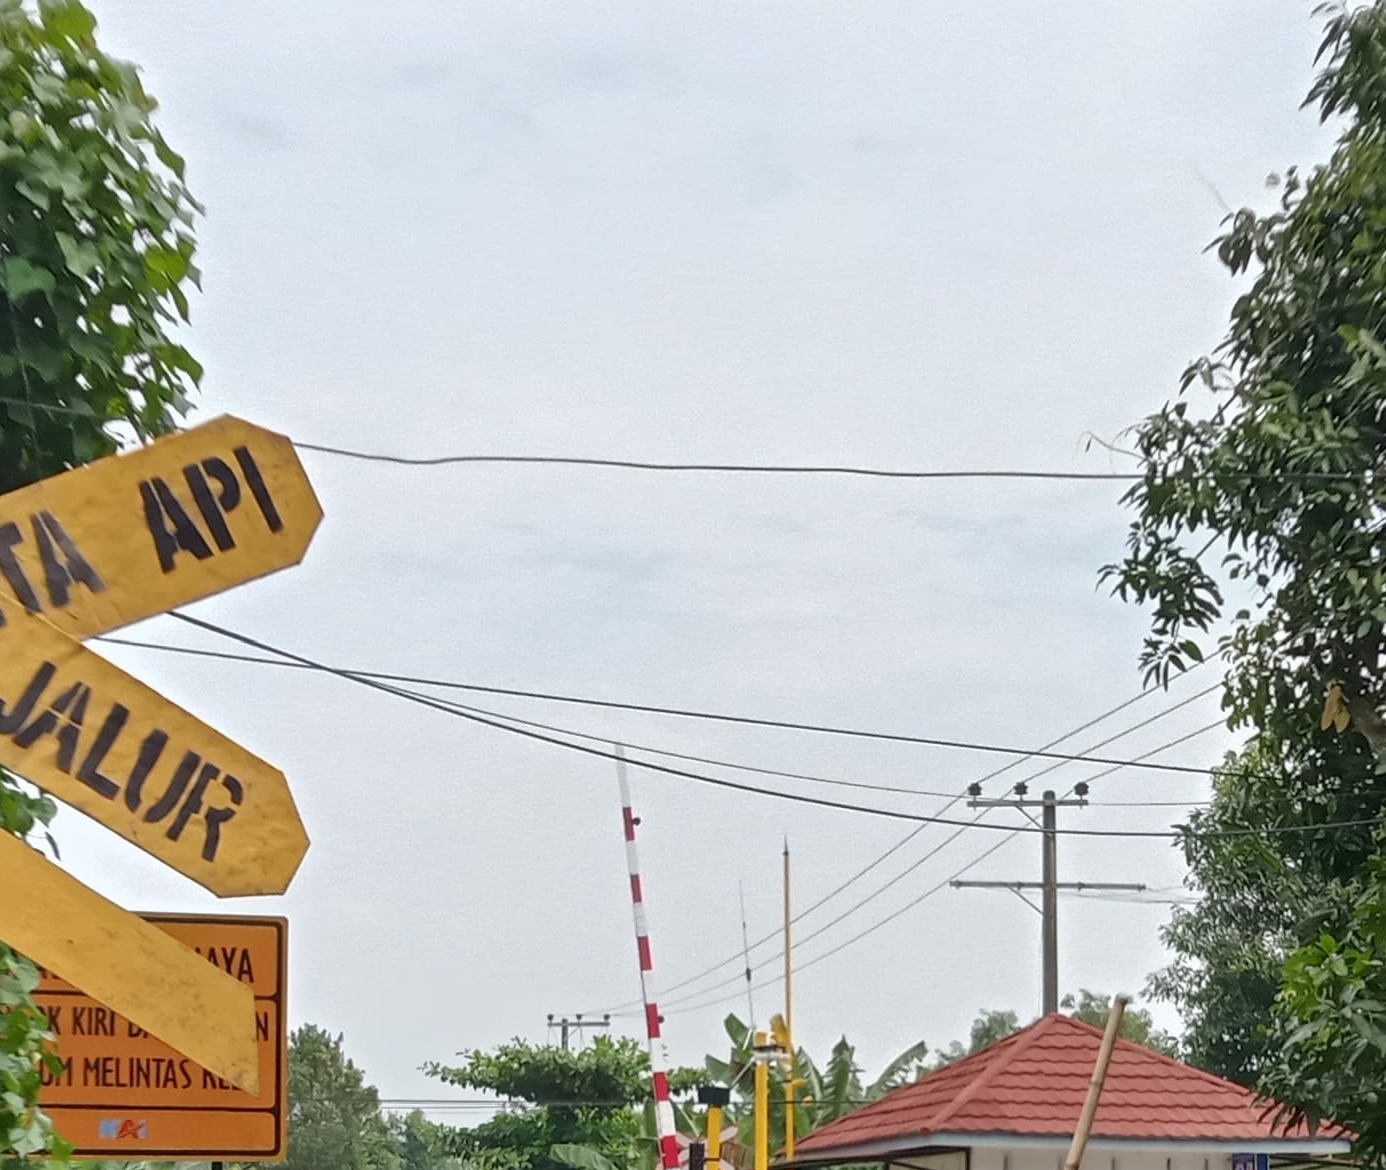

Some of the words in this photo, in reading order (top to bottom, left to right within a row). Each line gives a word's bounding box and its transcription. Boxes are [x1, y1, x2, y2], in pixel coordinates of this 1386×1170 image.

[137, 445, 284, 574] API
[73, 1006, 116, 1036] KIRI
[83, 1057, 193, 1089] MELINTAS
